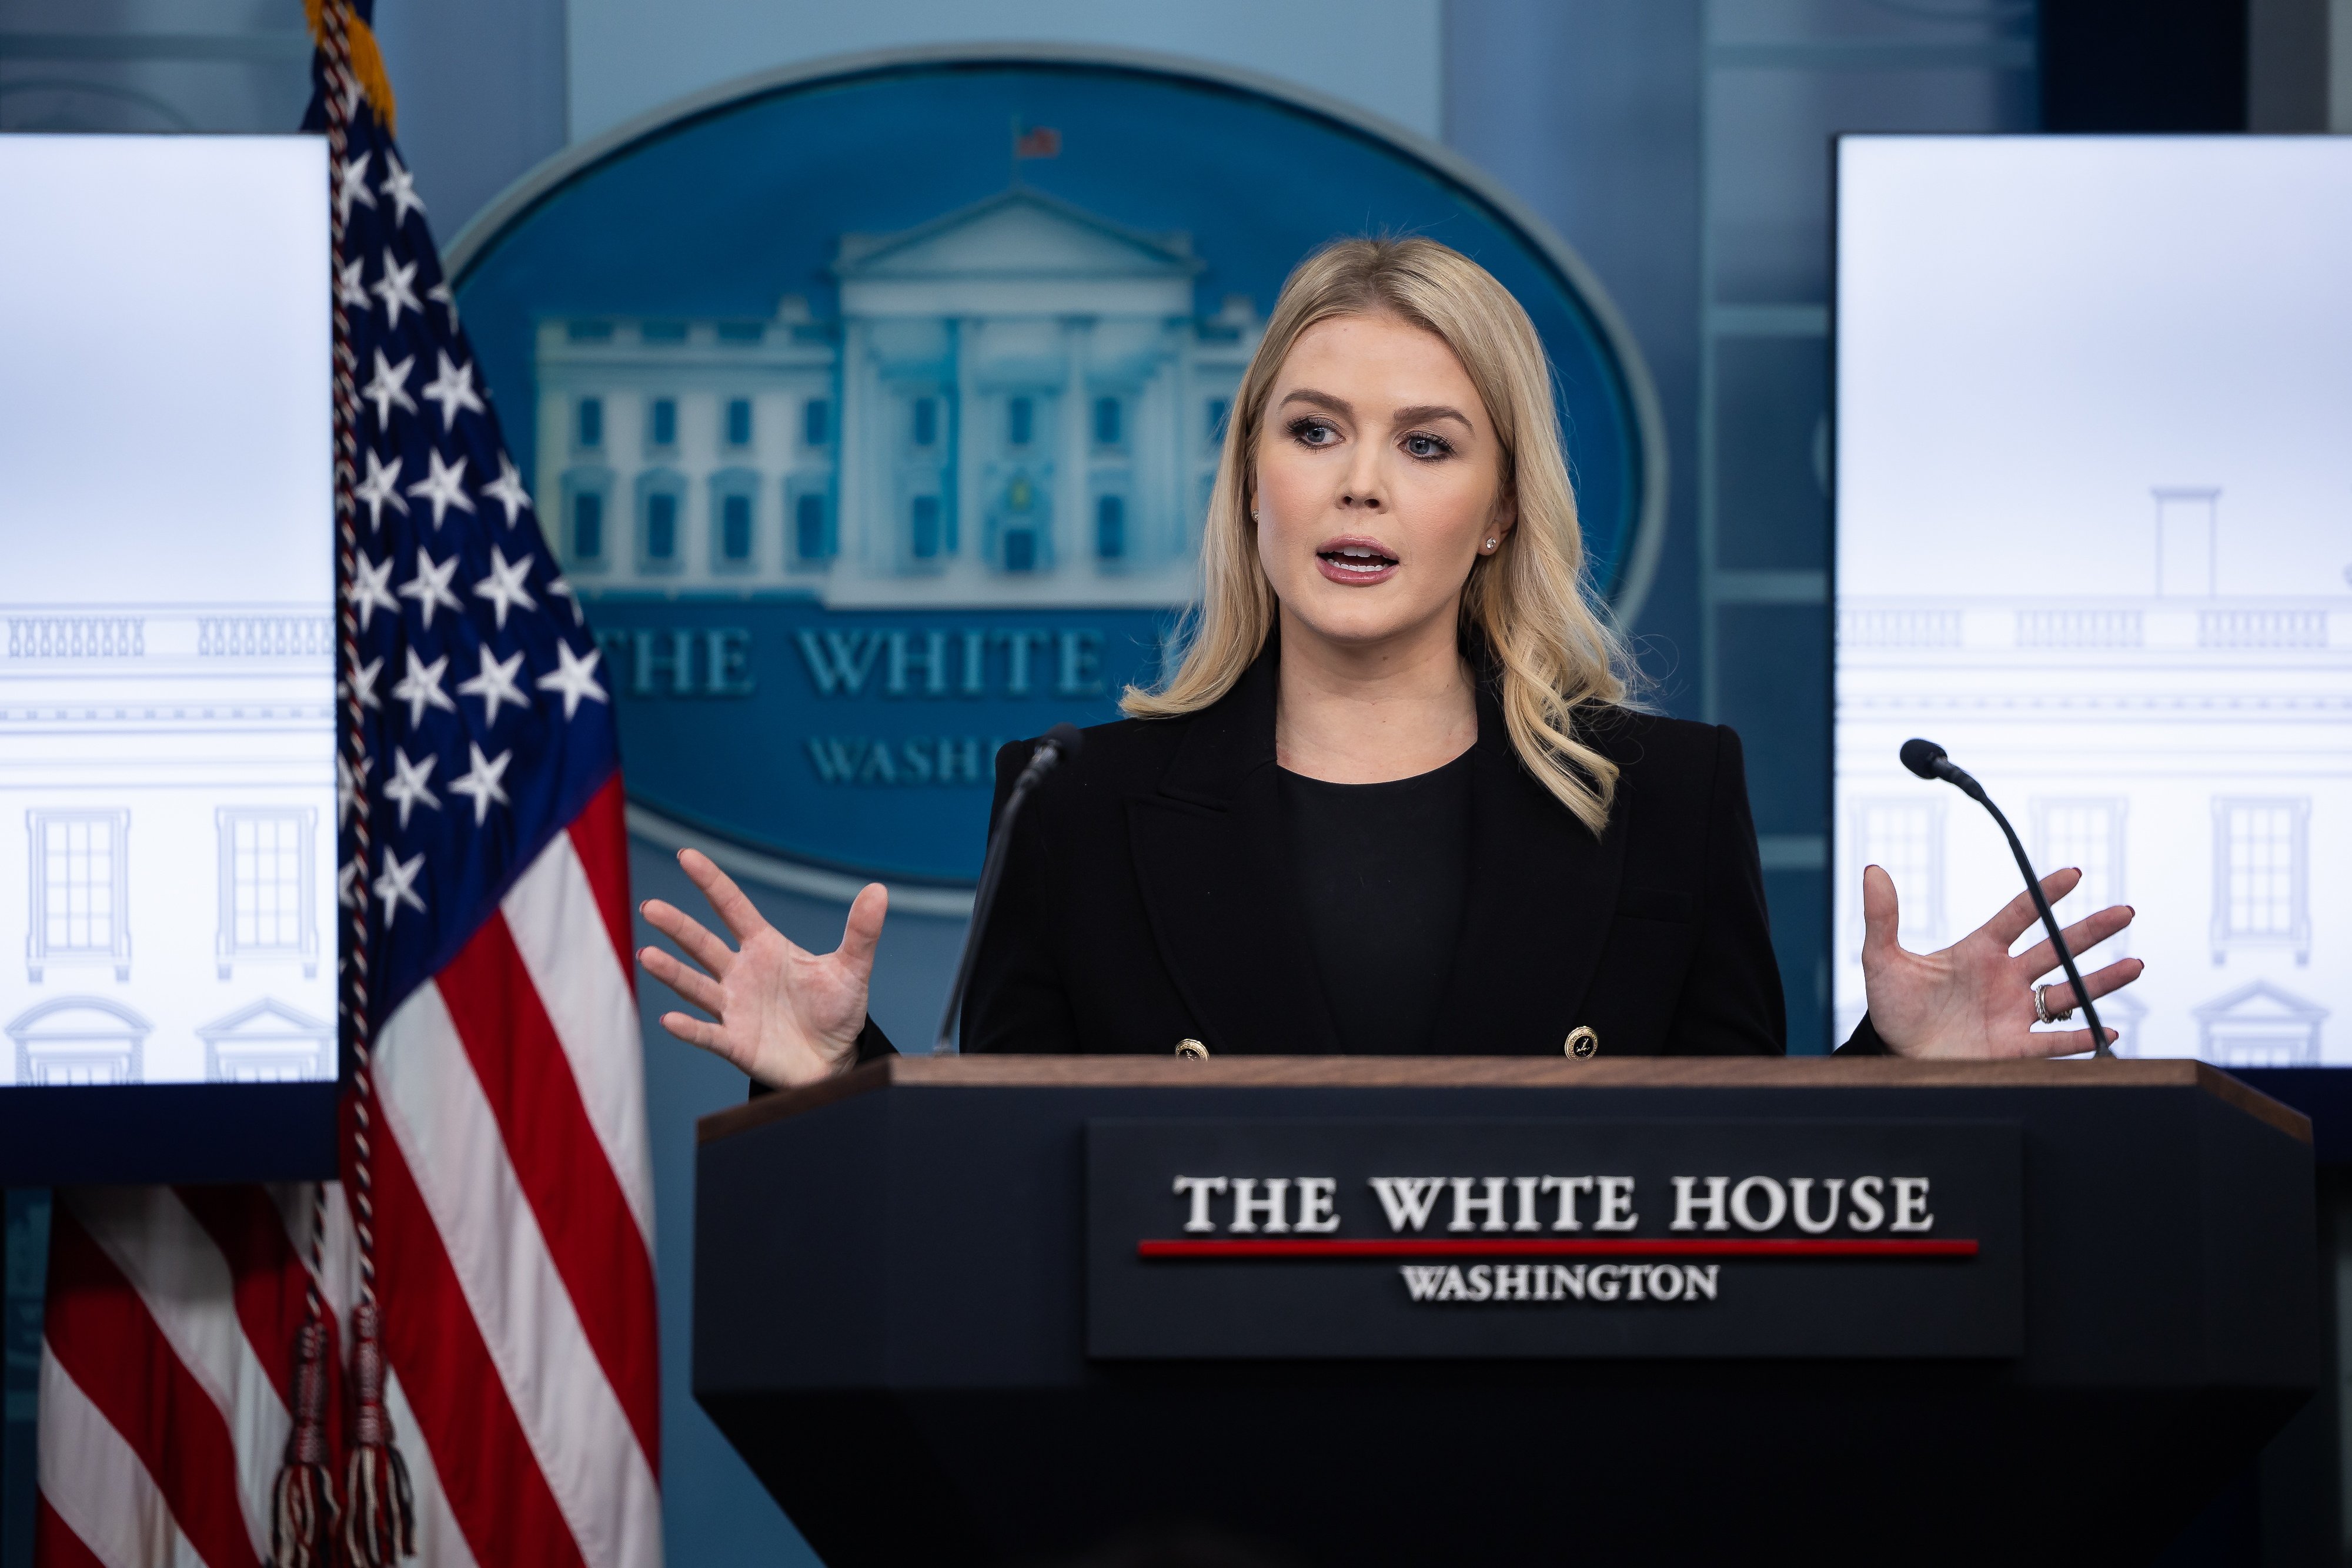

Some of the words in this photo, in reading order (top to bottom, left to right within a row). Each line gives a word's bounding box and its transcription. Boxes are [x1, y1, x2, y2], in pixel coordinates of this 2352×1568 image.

[797, 627, 1108, 696] WHITE
[1172, 1175, 1341, 1233] THE
[1369, 1175, 1638, 1232] WHITE
[1670, 1175, 1934, 1233] HOUSE
[1401, 1264, 1719, 1301] WASHINGTON
